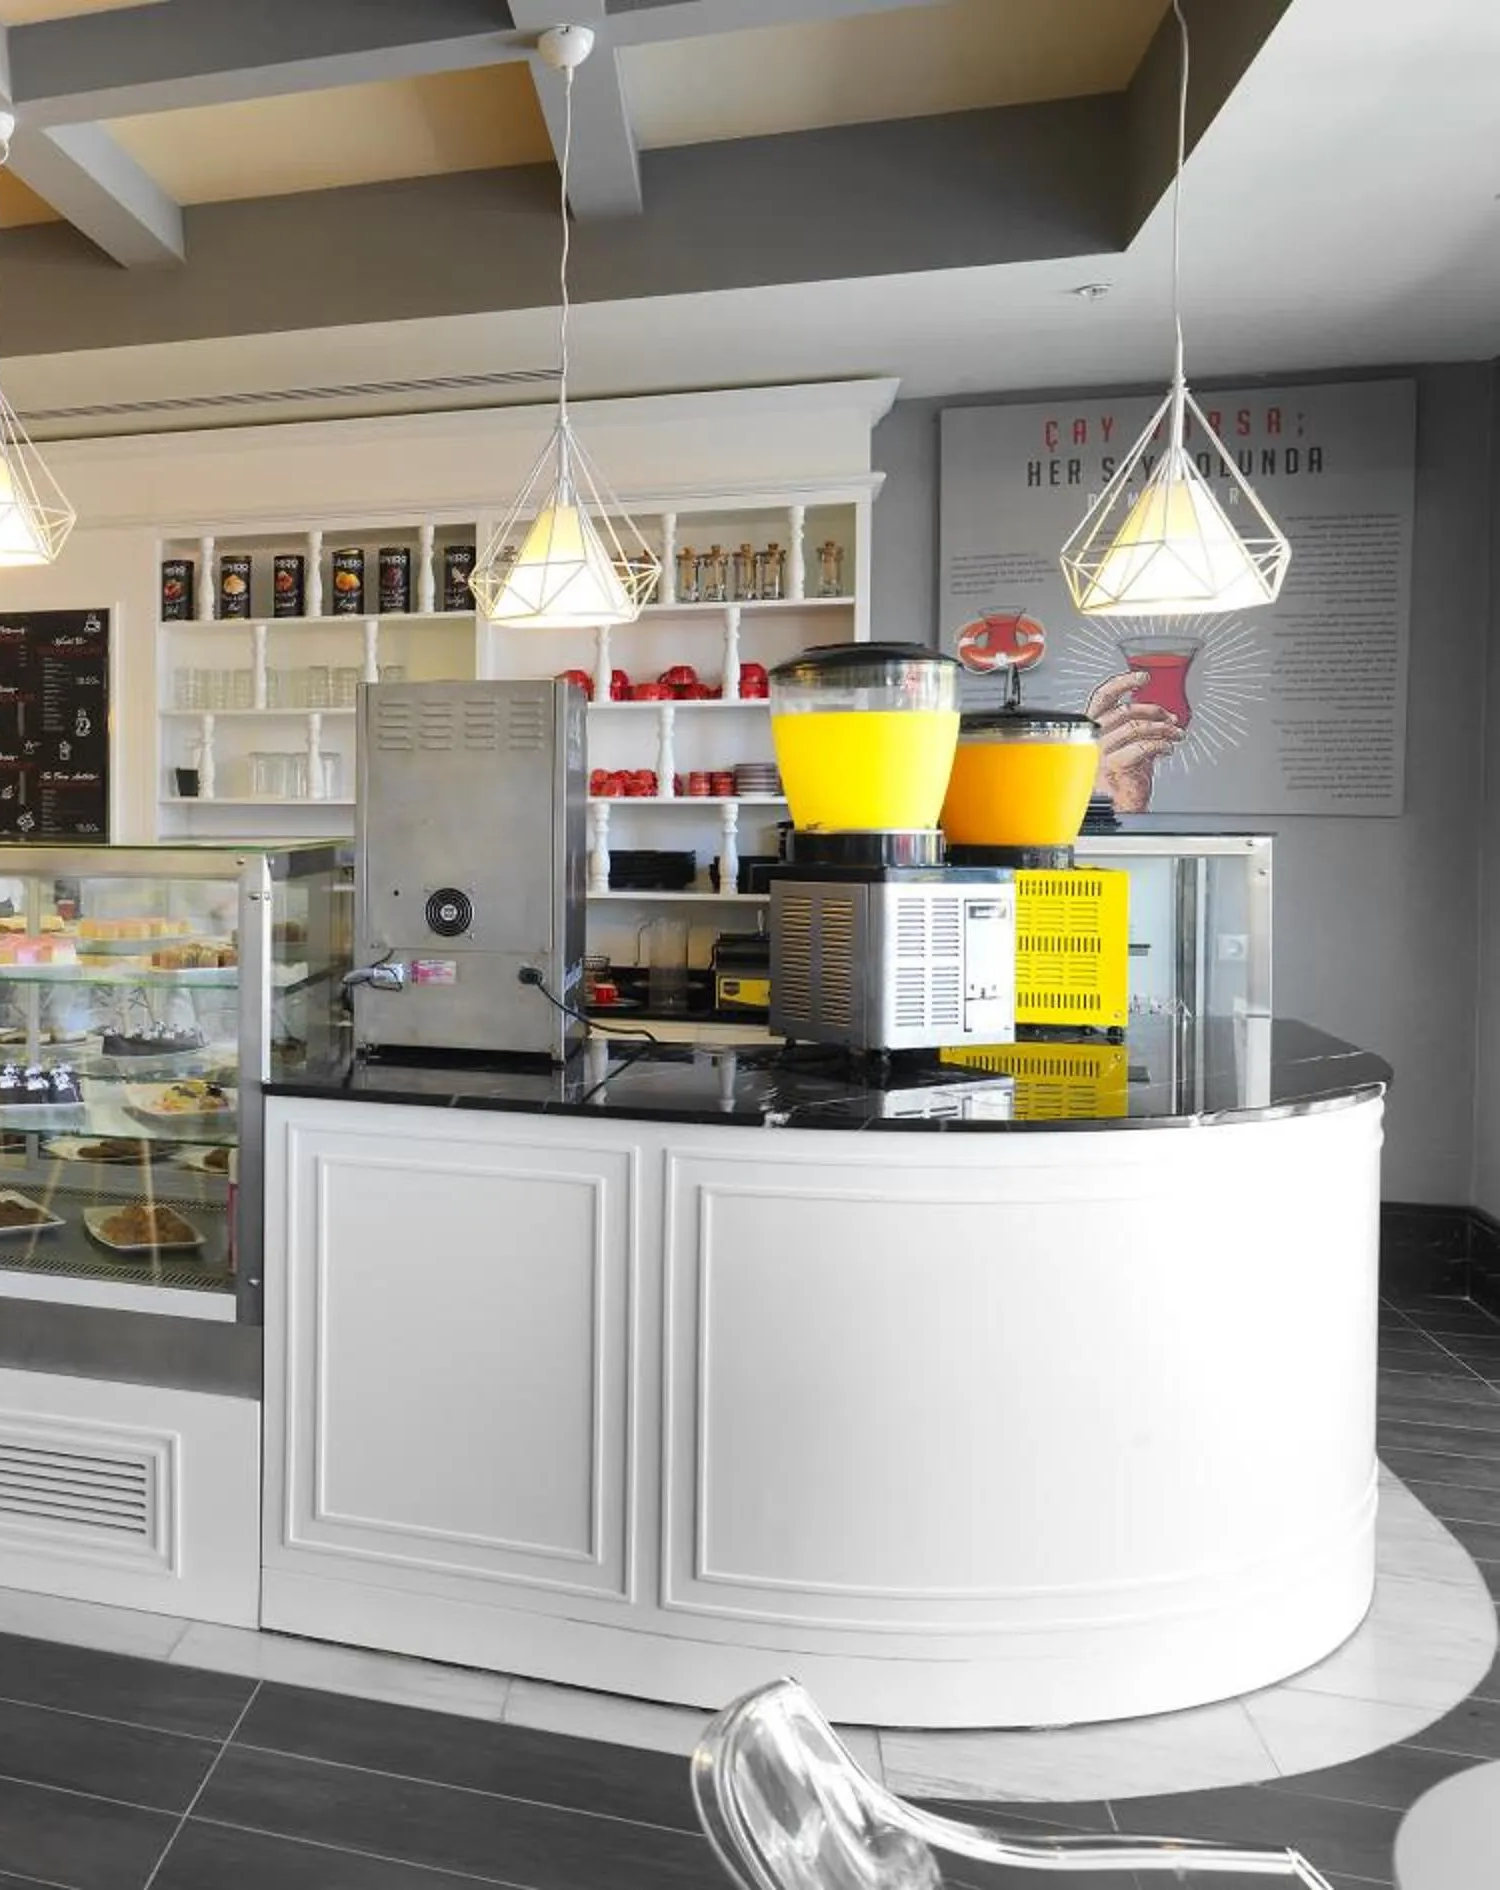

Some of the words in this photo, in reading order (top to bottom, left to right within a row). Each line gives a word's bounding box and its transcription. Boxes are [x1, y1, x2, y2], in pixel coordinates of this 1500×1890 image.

[1045, 416, 1113, 453] ÇAY
[1027, 458, 1081, 487] HER
[1177, 447, 1323, 480] OLUNDA
